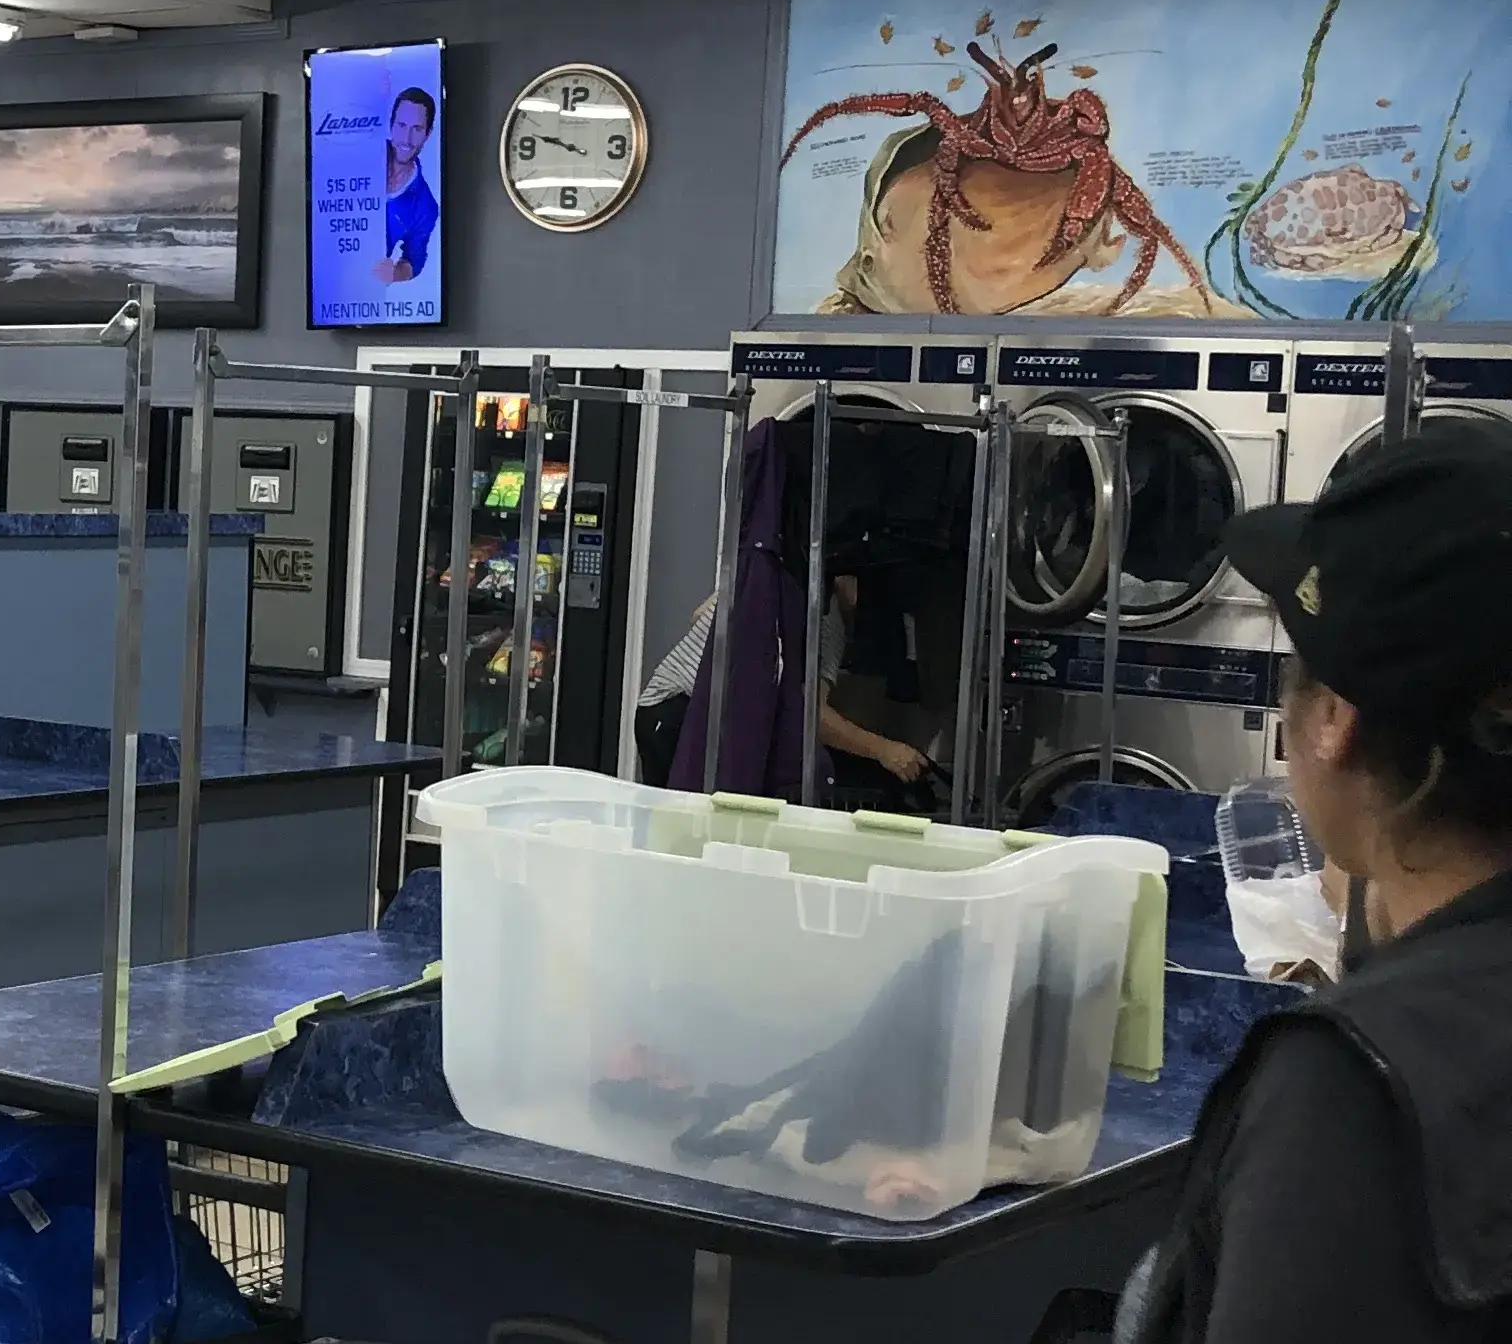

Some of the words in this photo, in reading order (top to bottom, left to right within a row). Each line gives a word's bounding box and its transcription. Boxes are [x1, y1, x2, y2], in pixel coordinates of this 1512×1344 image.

[562, 87, 589, 112] 12
[315, 113, 382, 135] Larsen
[518, 136, 536, 160] 9
[607, 135, 627, 159] 3
[327, 178, 346, 194] $15
[349, 177, 371, 192] OFF
[318, 199, 353, 213] WHEN
[356, 197, 381, 211] YOU
[560, 187, 577, 209] 6
[329, 218, 368, 232] SPEND
[338, 238, 360, 253] $50
[321, 303, 380, 319] MENTION
[384, 302, 413, 317] THIS
[416, 301, 434, 317] AD
[748, 351, 806, 360] DEXTER
[1015, 356, 1081, 365] DEXTER
[1313, 363, 1386, 372] DEXTER
